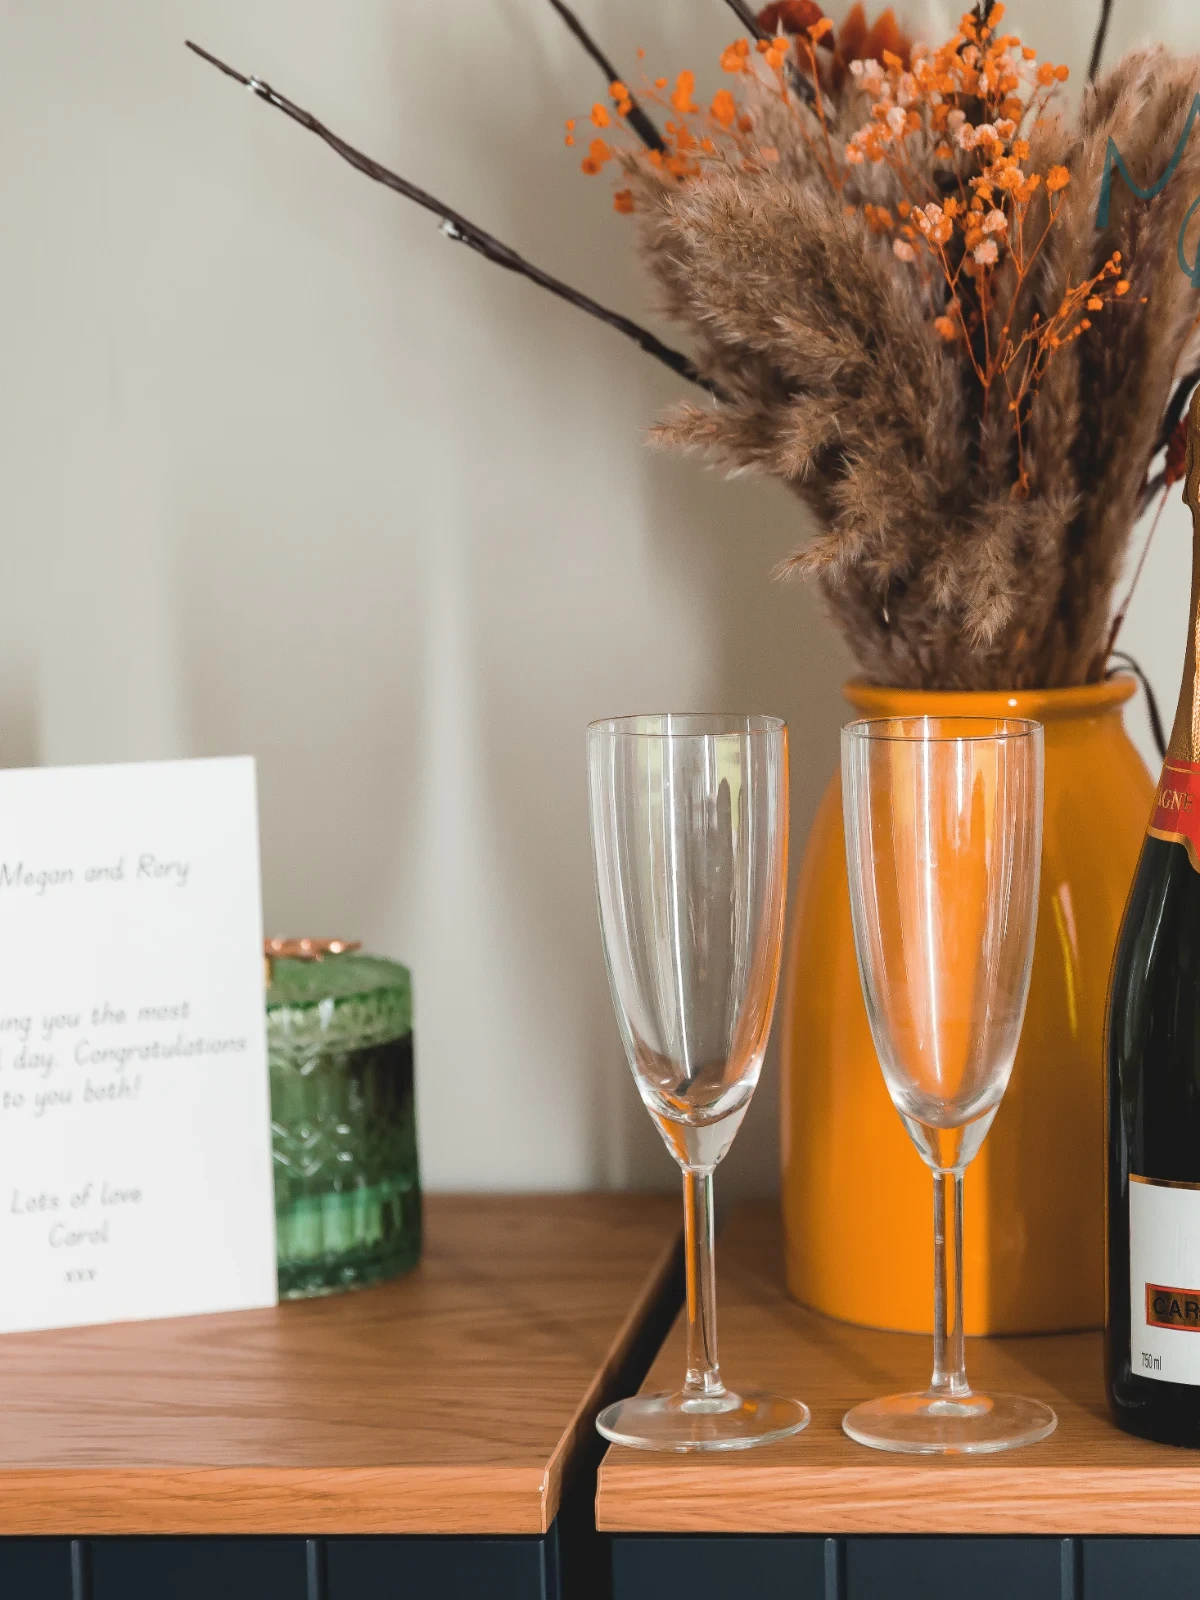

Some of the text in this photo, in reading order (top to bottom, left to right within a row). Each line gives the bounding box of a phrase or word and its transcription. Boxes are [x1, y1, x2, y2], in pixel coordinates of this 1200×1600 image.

[0, 851, 191, 896] Megan and Rory
[41, 1012, 81, 1042] you
[91, 1000, 127, 1027] the
[138, 999, 191, 1024] most
[74, 1032, 249, 1075] Congratulations
[2, 1072, 143, 1116] to you both!
[10, 1179, 143, 1216] Lots of love
[48, 1217, 111, 1249] Carol
